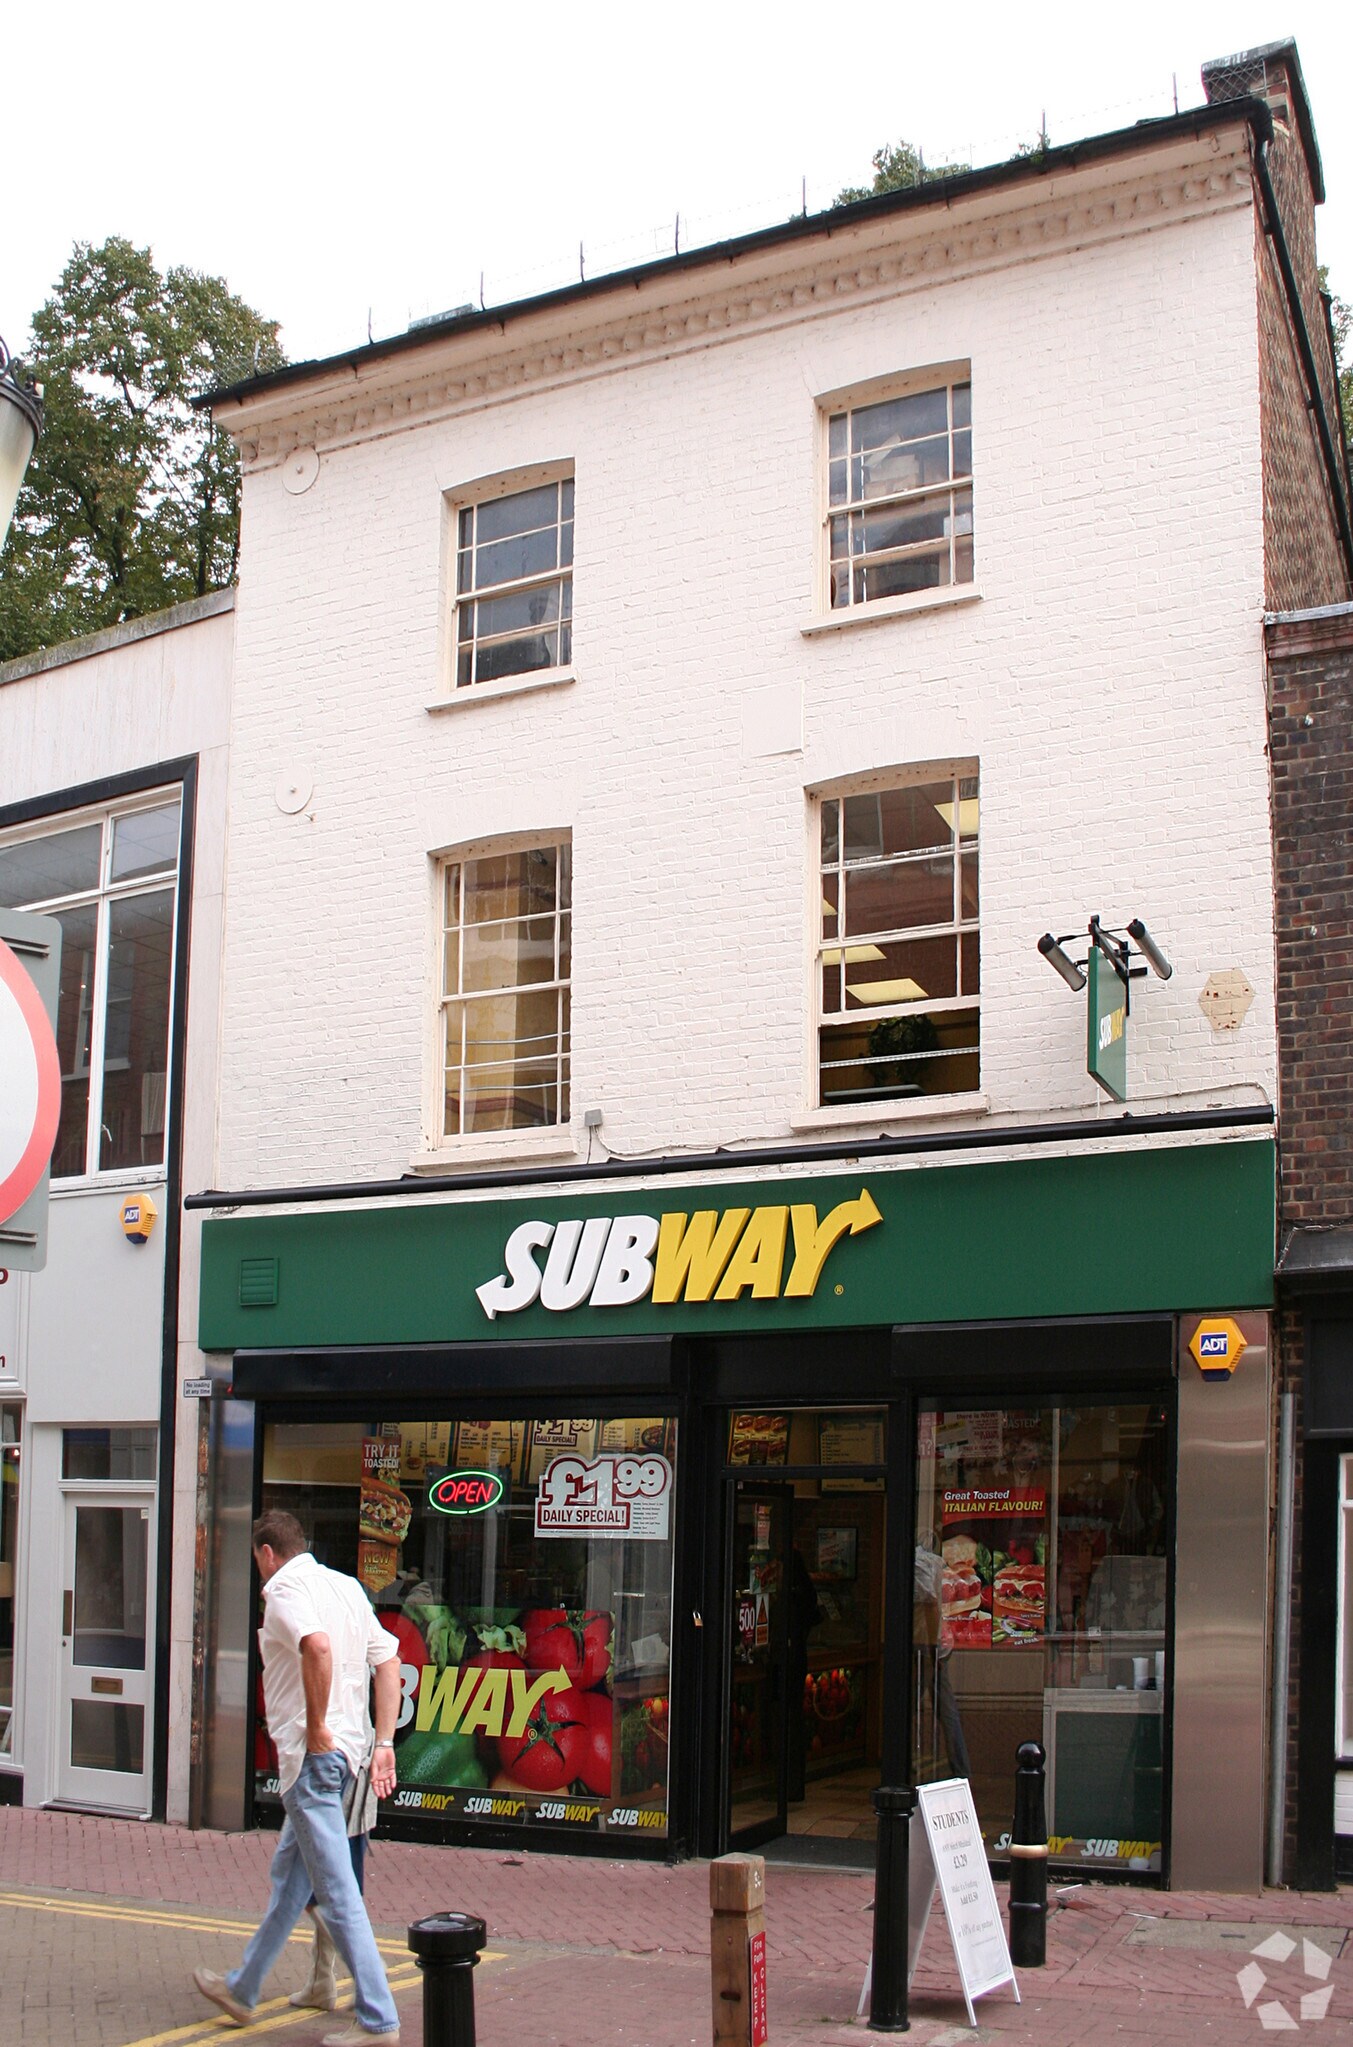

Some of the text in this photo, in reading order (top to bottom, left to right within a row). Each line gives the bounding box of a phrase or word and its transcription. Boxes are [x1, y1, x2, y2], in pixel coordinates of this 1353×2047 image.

[125, 1209, 139, 1220] ADT
[475, 1188, 883, 1320] SUBWAY
[1201, 1338, 1227, 1352] ADT
[536, 1435, 551, 1443] DAILY
[364, 1444, 400, 1458] TRY IT
[364, 1458, 399, 1469] TOASTED!
[438, 1480, 494, 1503] OPEN
[944, 1490, 1010, 1501] Great Toasted
[543, 1509, 573, 1523] DAILY
[575, 1509, 625, 1523] SPECIAL!
[944, 1501, 1043, 1513] ITALIAN FLAVOUR!
[738, 1606, 756, 1632] 500
[397, 1664, 572, 1738] BWAY
[394, 1790, 455, 1811] SUBWAY
[463, 1797, 526, 1817] SUBWAY
[535, 1802, 600, 1823] SUBWAY
[607, 1808, 668, 1829] SUBWAY
[932, 1810, 969, 1831] STUDENTS
[1080, 1838, 1162, 1860] SUBWAY
